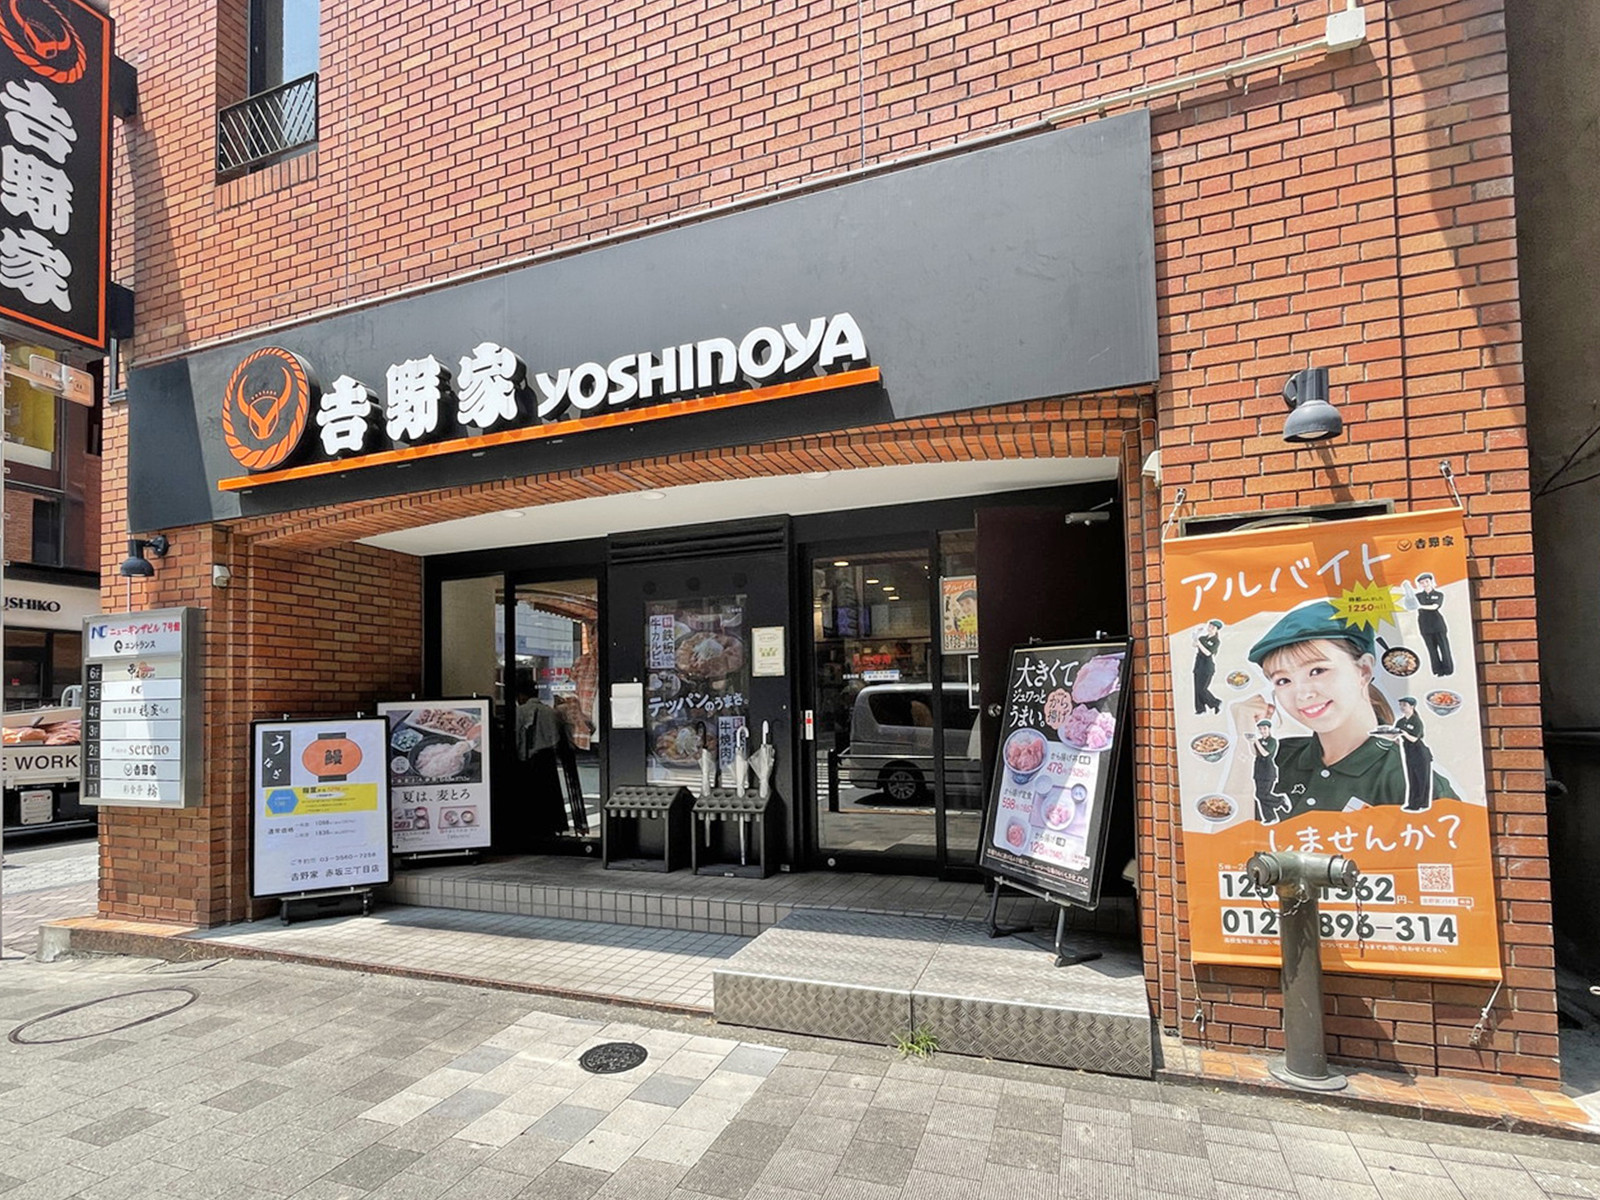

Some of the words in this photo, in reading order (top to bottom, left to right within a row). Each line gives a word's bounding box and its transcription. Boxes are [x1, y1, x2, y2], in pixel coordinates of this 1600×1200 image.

[316, 342, 520, 456] 吉野家
[535, 312, 868, 419] YOSHINOYA
[1180, 543, 1392, 611] アルバイト
[89, 667, 100, 679] 6F
[1013, 657, 1079, 689] 大きくて
[89, 686, 100, 698] 5F
[1012, 688, 1047, 704] ジュワっと
[88, 706, 99, 717] 4F
[1009, 704, 1046, 728] うまい。
[88, 725, 99, 736] 3F
[88, 744, 99, 756] 2F
[128, 744, 170, 755] sereno
[263, 734, 285, 780] うなぎ
[89, 764, 99, 775] 1F
[402, 788, 471, 803] 夏は、麦とろ
[325, 864, 380, 878] 赤坂三丁目店
